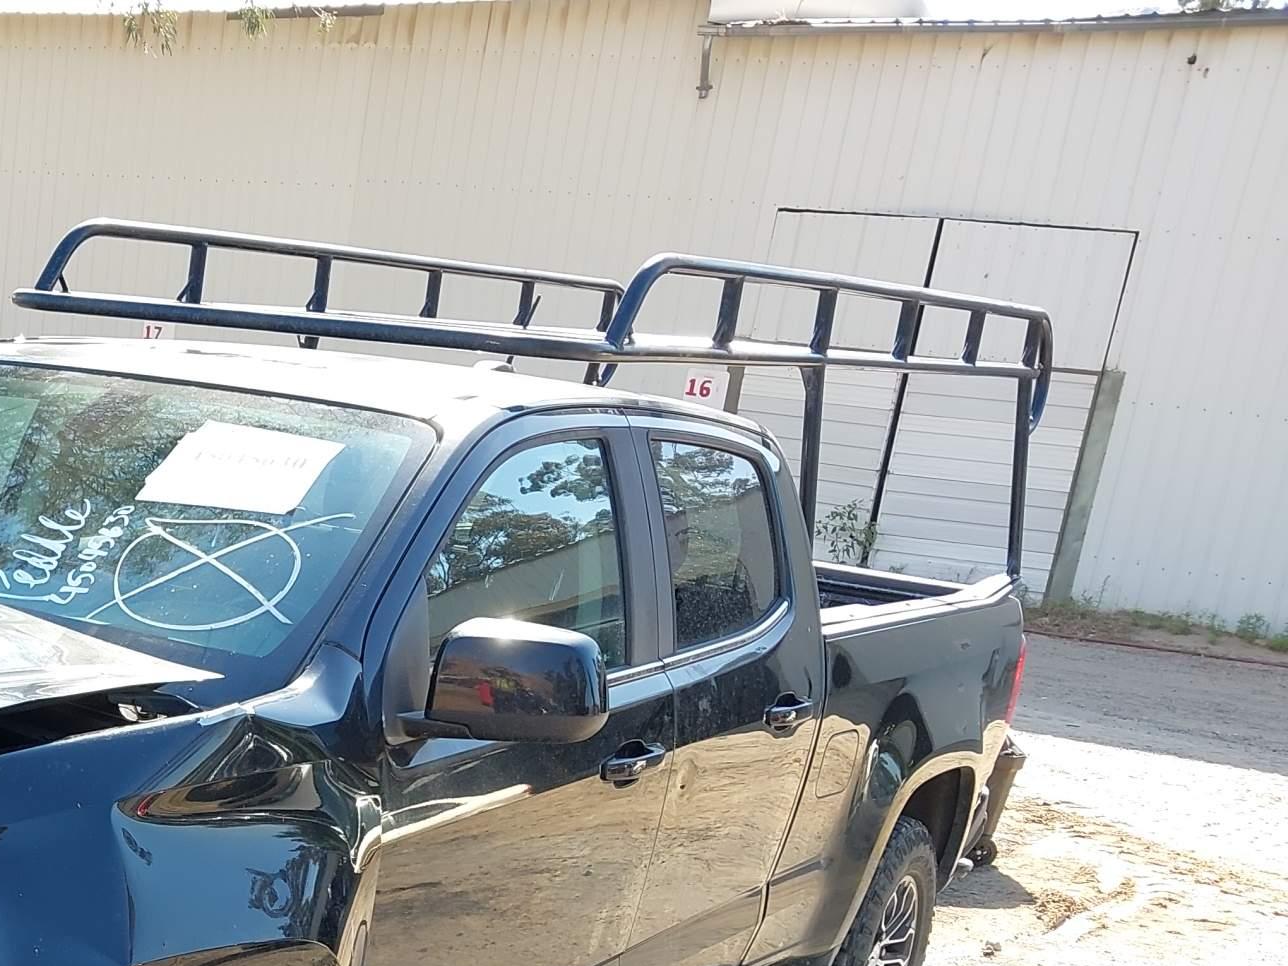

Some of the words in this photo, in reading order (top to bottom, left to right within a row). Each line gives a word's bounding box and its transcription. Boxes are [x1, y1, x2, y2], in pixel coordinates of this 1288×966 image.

[144, 325, 163, 339] 17
[685, 378, 713, 398] 16
[50, 504, 136, 604] 45045630
